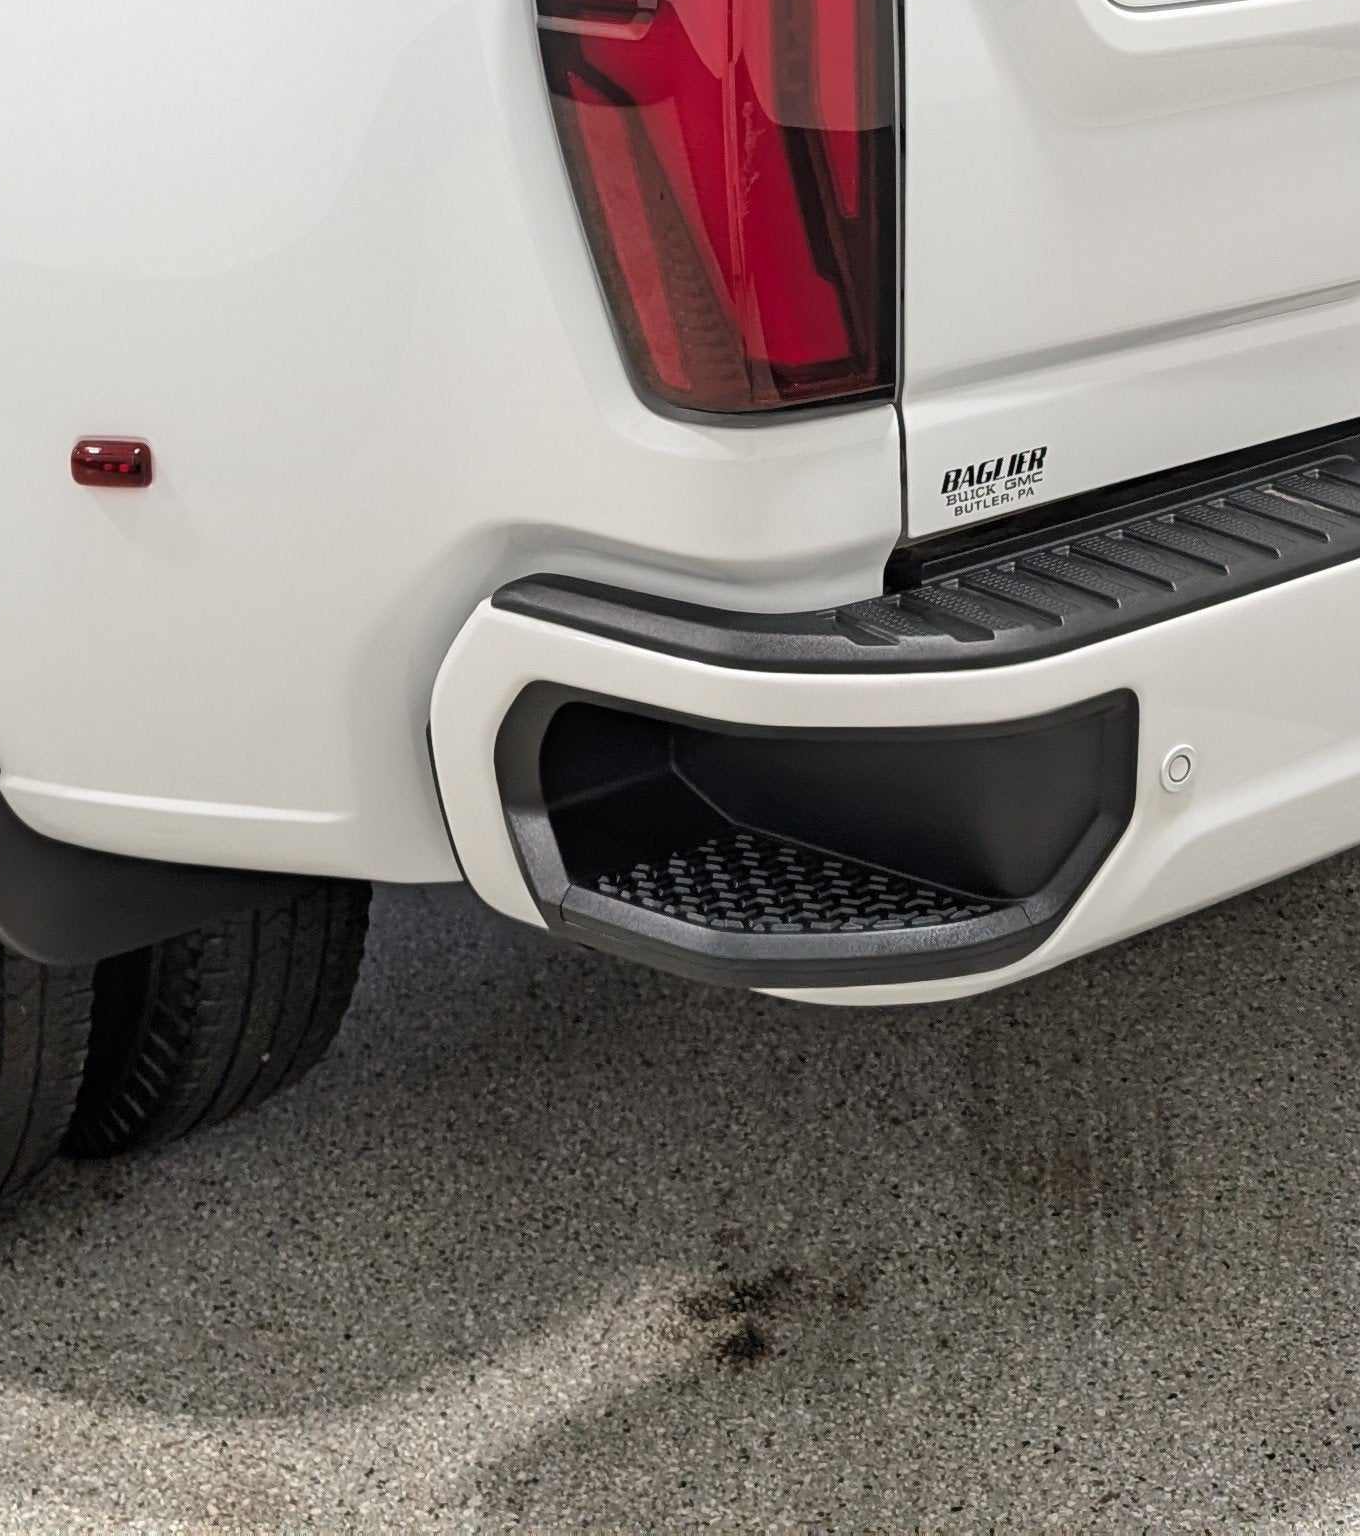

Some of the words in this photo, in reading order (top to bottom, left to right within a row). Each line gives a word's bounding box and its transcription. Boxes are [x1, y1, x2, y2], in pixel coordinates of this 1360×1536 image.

[941, 446, 1048, 495] BAGLIER
[946, 483, 997, 507] BUICK
[1004, 471, 1044, 491] GMC
[954, 494, 1014, 517] BUTLER,
[1017, 486, 1035, 500] PA
